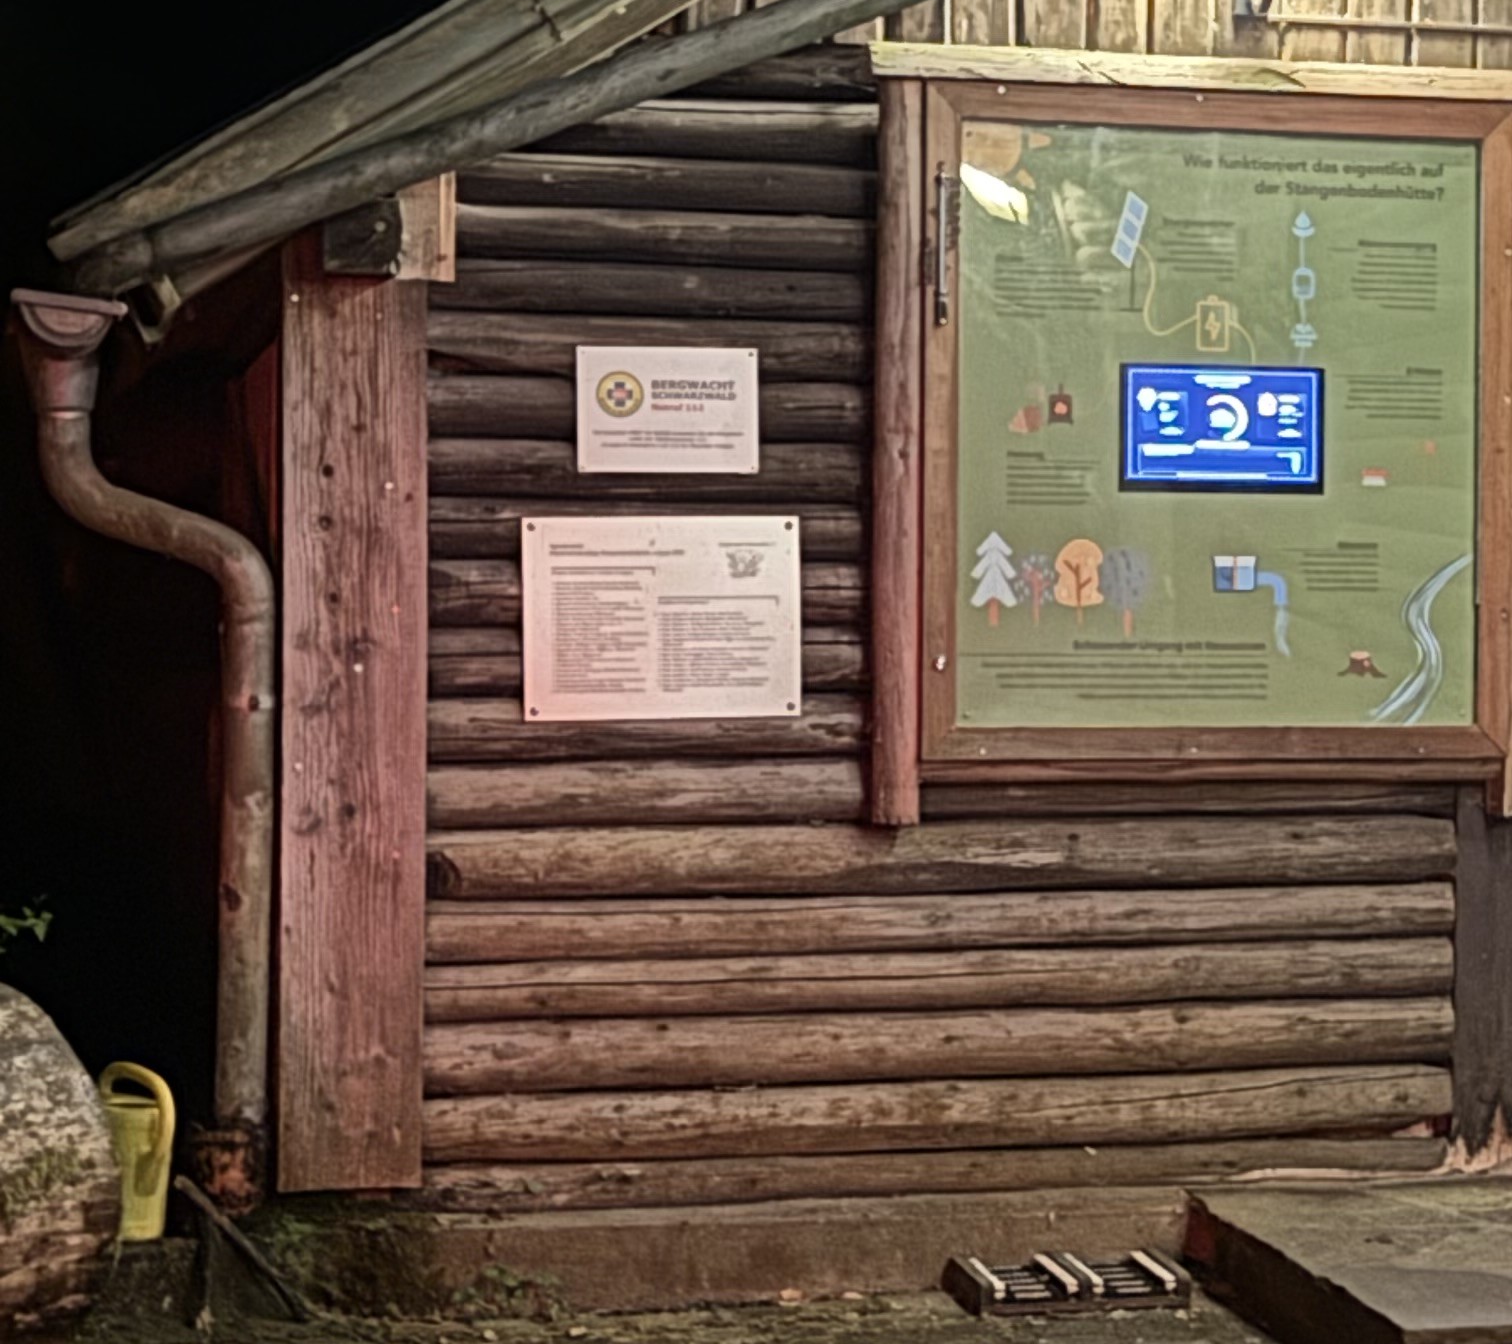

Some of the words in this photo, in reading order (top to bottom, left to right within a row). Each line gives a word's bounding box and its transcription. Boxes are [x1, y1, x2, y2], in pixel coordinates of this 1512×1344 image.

[1183, 155, 1213, 169] Wie
[1218, 156, 1308, 172] funktioniert
[1311, 159, 1339, 174] das
[1342, 161, 1417, 178] eigentlich
[1420, 162, 1445, 178] auf
[1254, 180, 1280, 195] der
[1285, 180, 1446, 201] Stangenbodenhütte?
[651, 379, 736, 391] BERGWACHT
[651, 391, 737, 401] SCHWARZWALD
